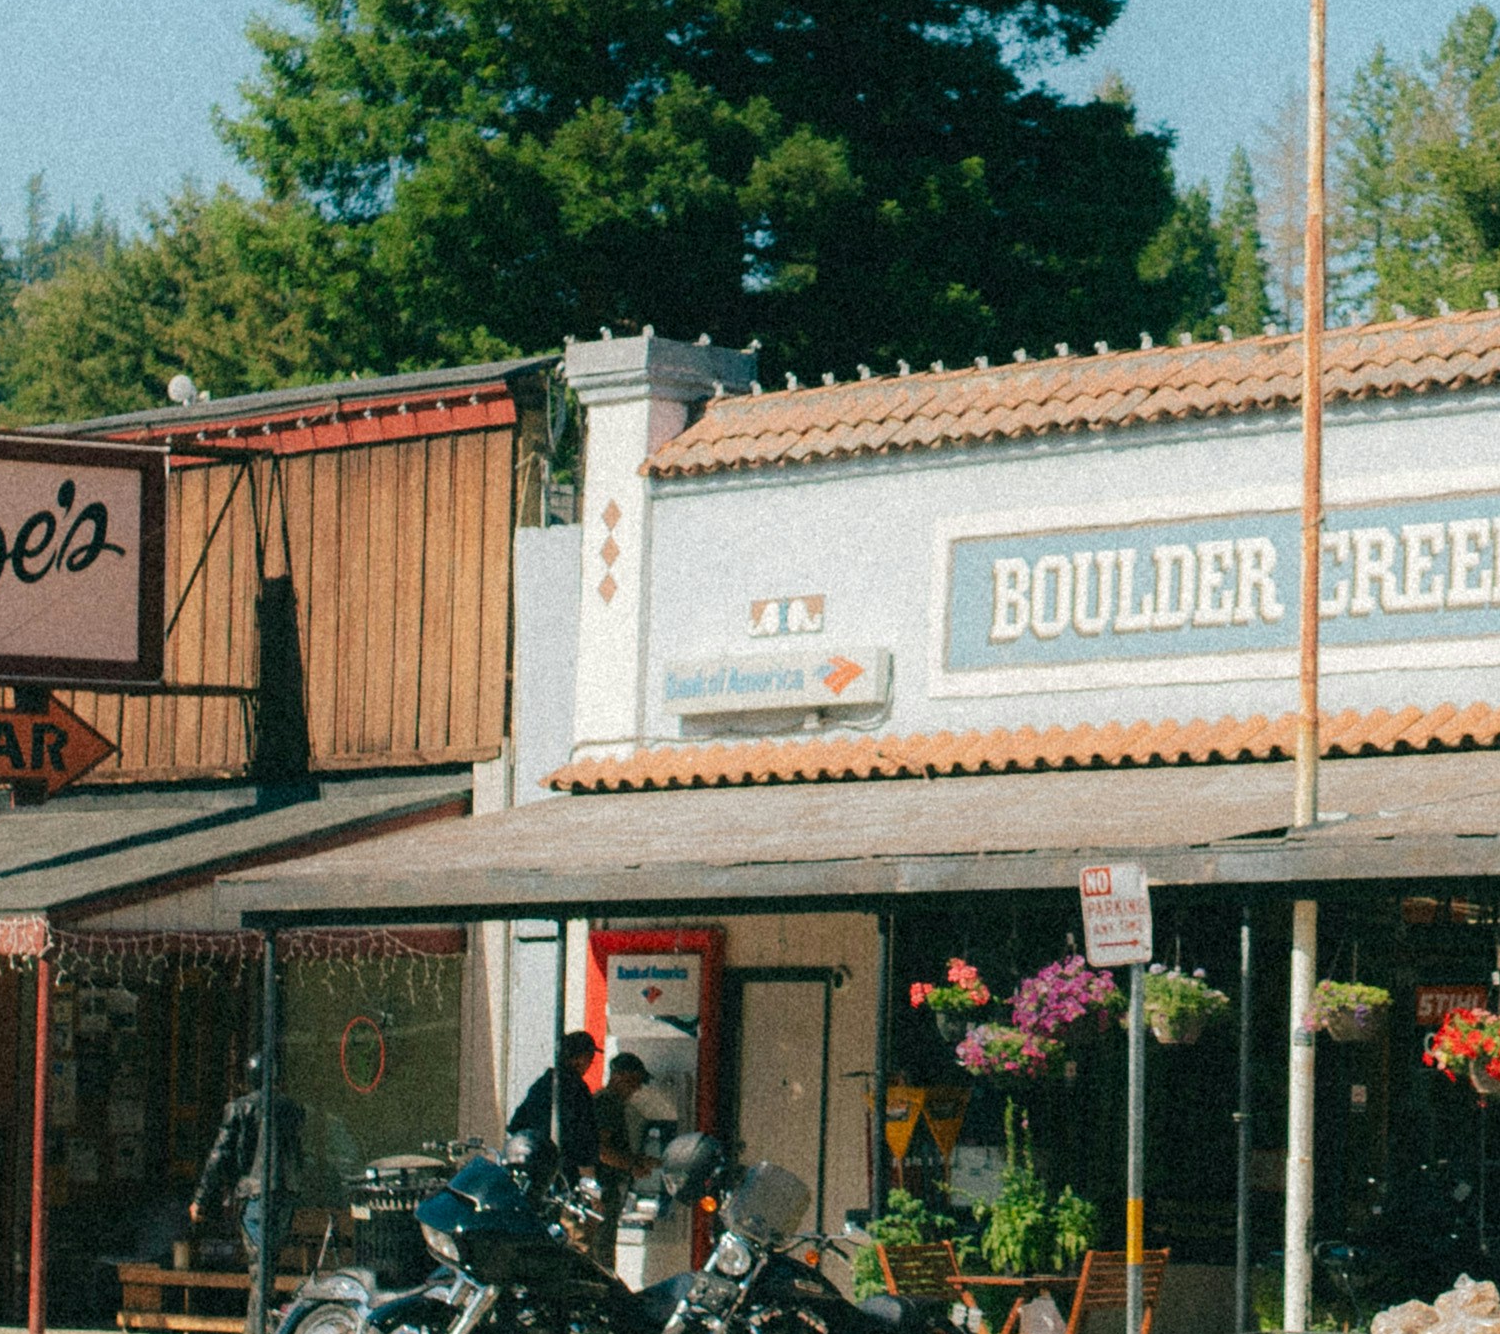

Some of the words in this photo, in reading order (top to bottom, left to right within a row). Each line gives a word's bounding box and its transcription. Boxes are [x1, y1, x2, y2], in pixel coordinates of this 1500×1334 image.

[988, 536, 1286, 644] BOULDER
[665, 671, 704, 700] Bank
[728, 666, 805, 694] America
[1084, 870, 1110, 895] NO
